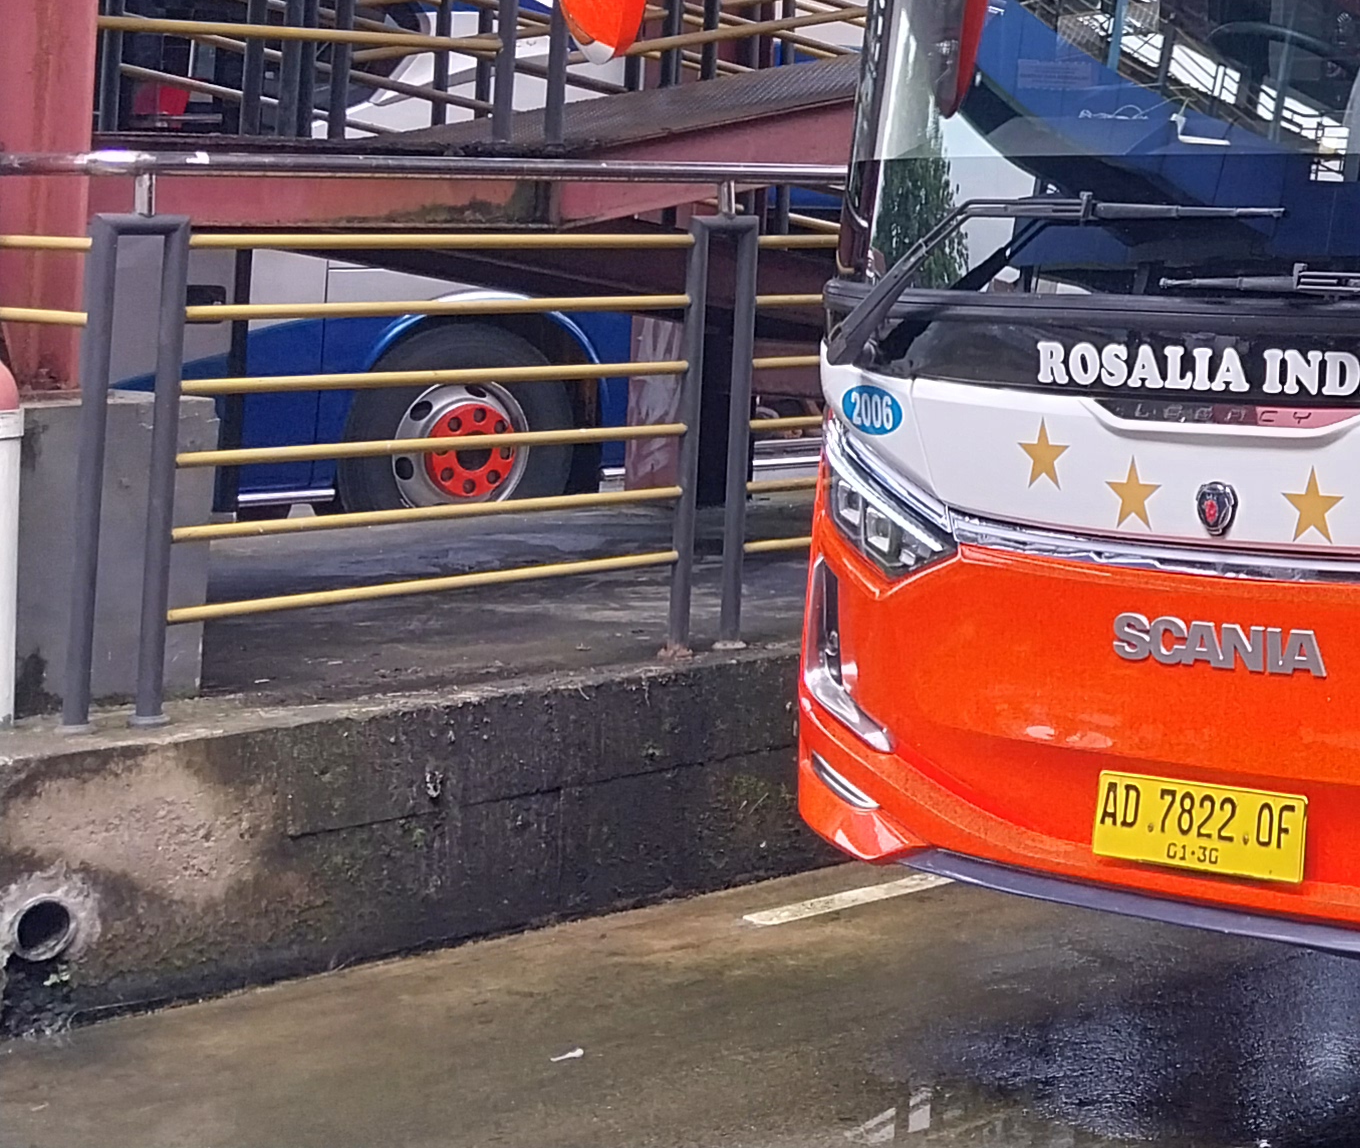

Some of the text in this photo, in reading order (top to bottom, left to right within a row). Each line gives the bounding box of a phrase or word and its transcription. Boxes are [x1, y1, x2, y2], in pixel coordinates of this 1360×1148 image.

[1037, 341, 1250, 393] ROSALIA
[851, 391, 893, 430] 2006
[1113, 612, 1327, 677] SCANIA
